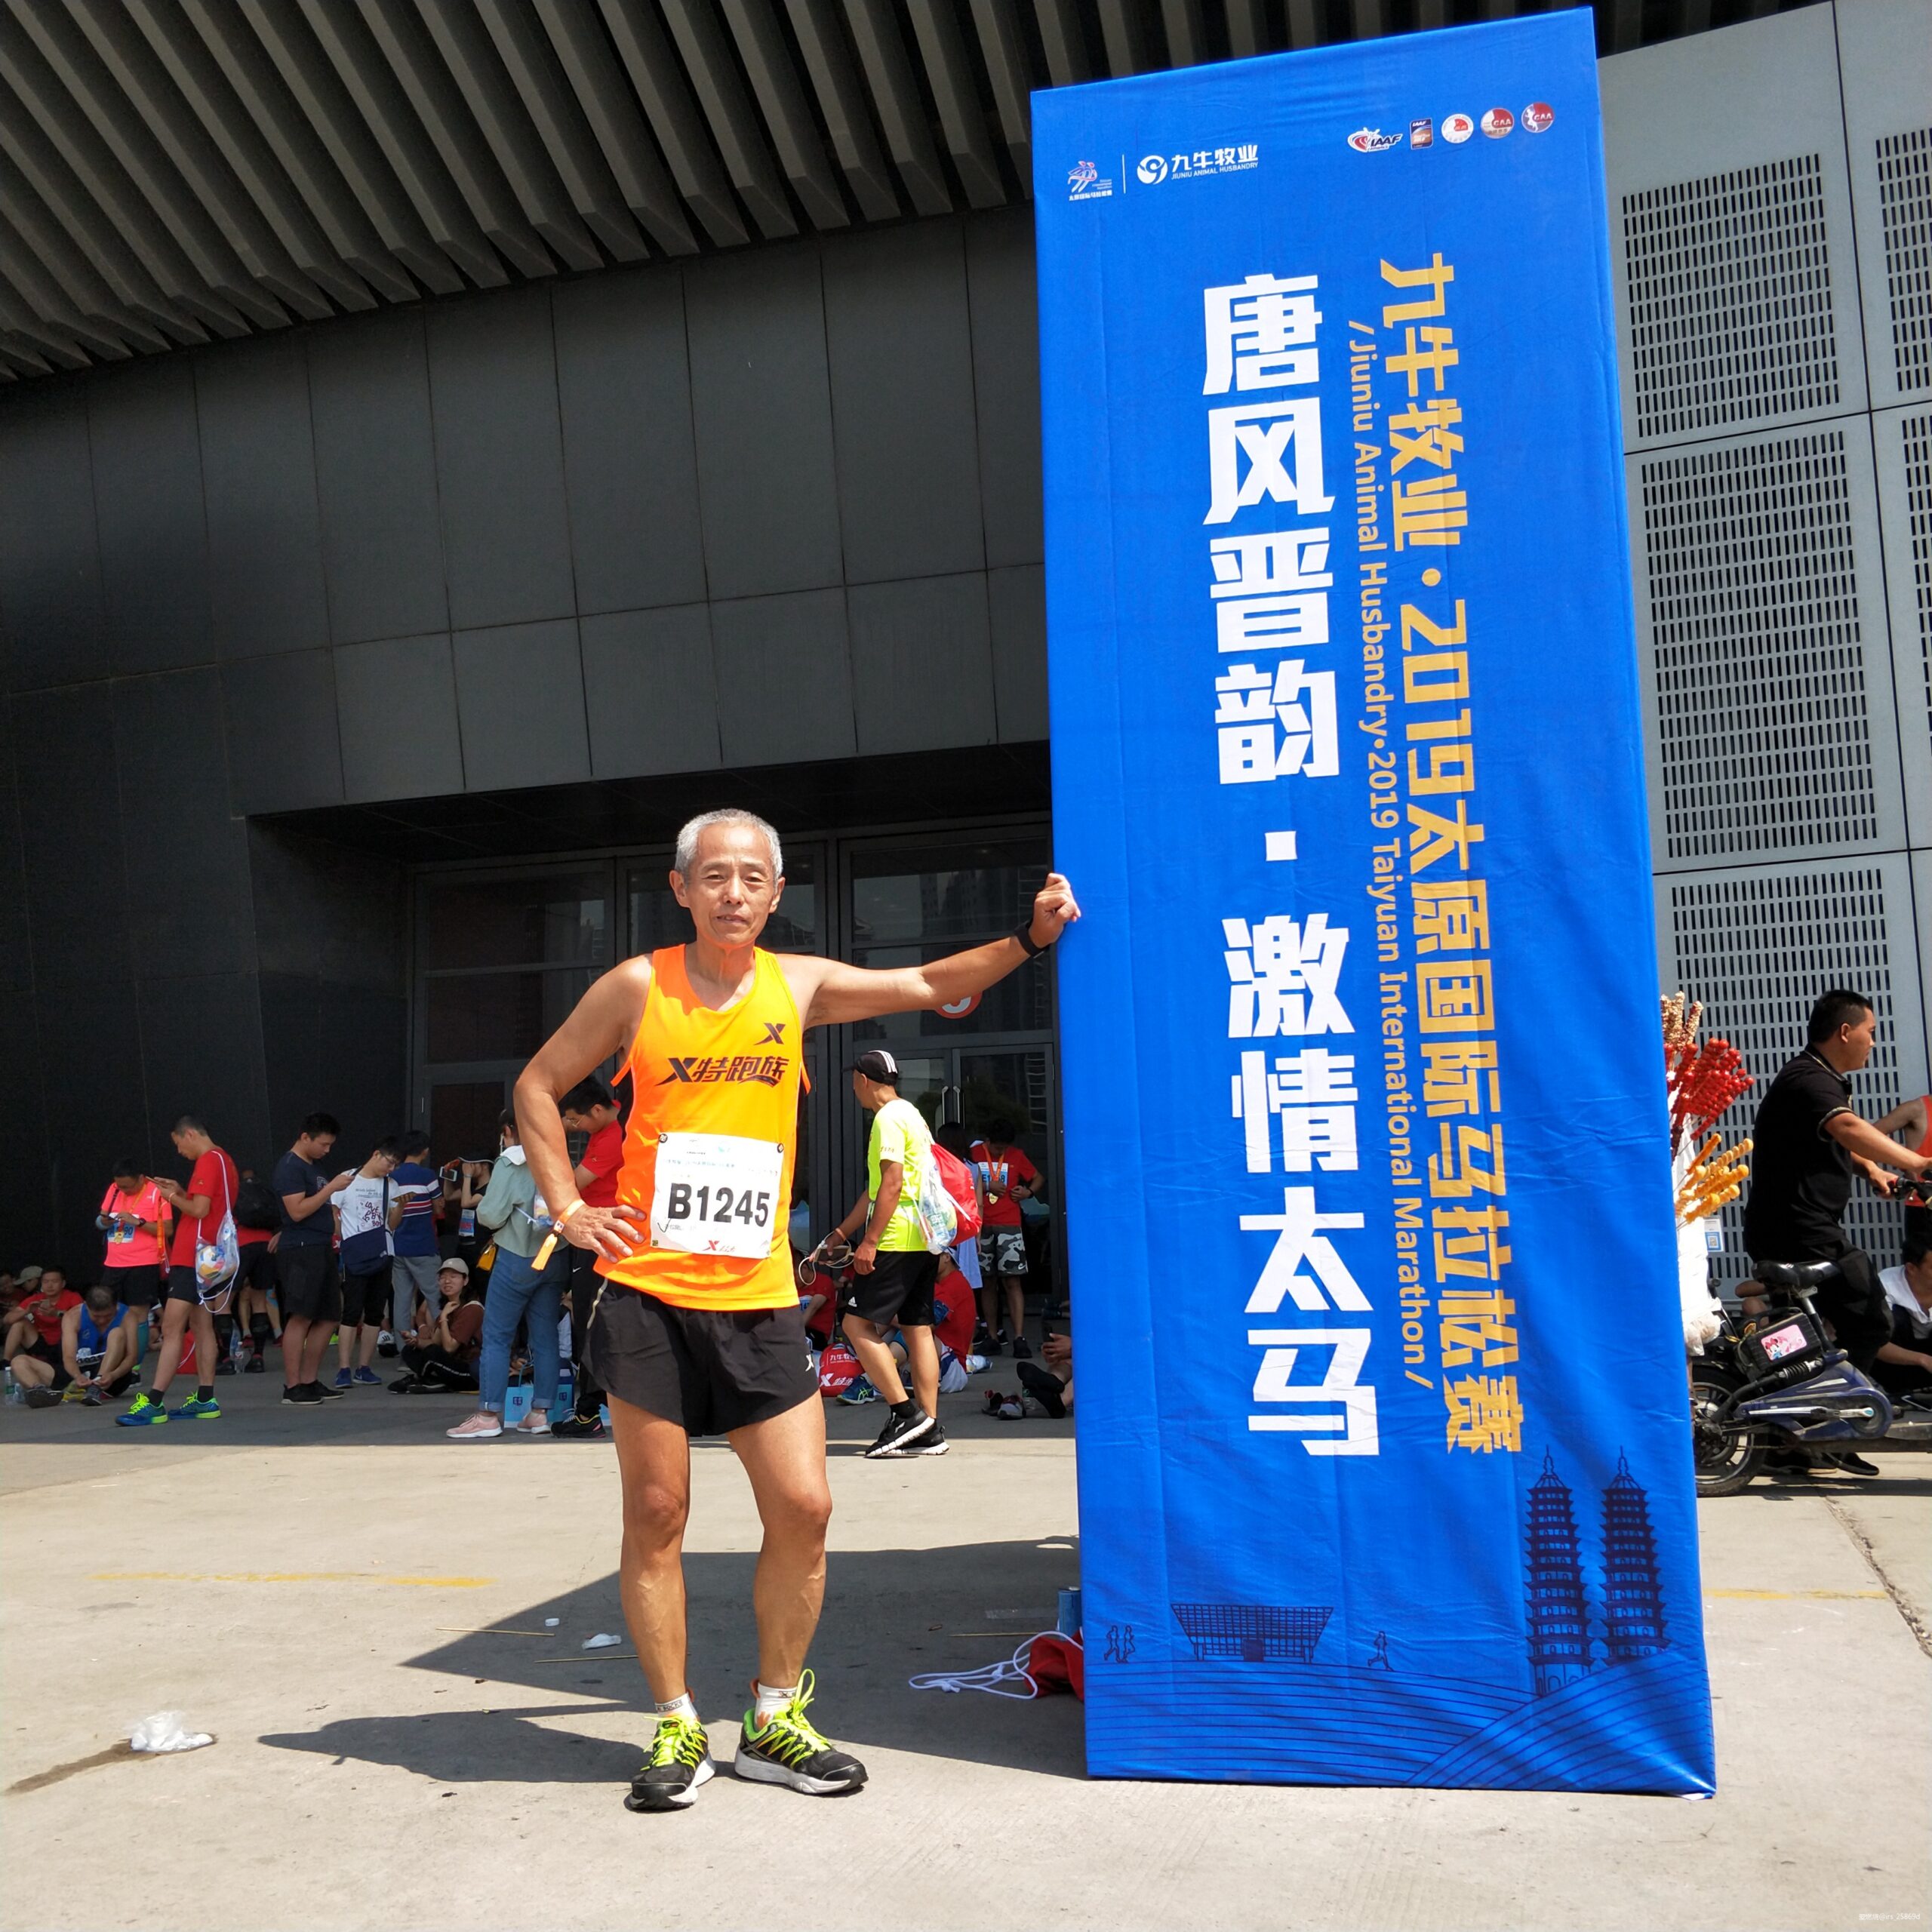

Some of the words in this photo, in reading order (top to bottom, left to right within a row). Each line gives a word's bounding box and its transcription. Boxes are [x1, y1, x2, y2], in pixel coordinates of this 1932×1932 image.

[1171, 144, 1258, 173] 九牛牧业
[1371, 134, 1402, 146] IAAF
[1171, 172, 1192, 180] JIUNIU
[1193, 168, 1217, 177] ANIMAL
[1220, 162, 1258, 173] HUSBANDRY
[1354, 441, 1387, 551] Animal
[1366, 838, 1403, 961] Taiyuan
[1380, 971, 1422, 1186] International
[668, 1183, 770, 1227] B1245
